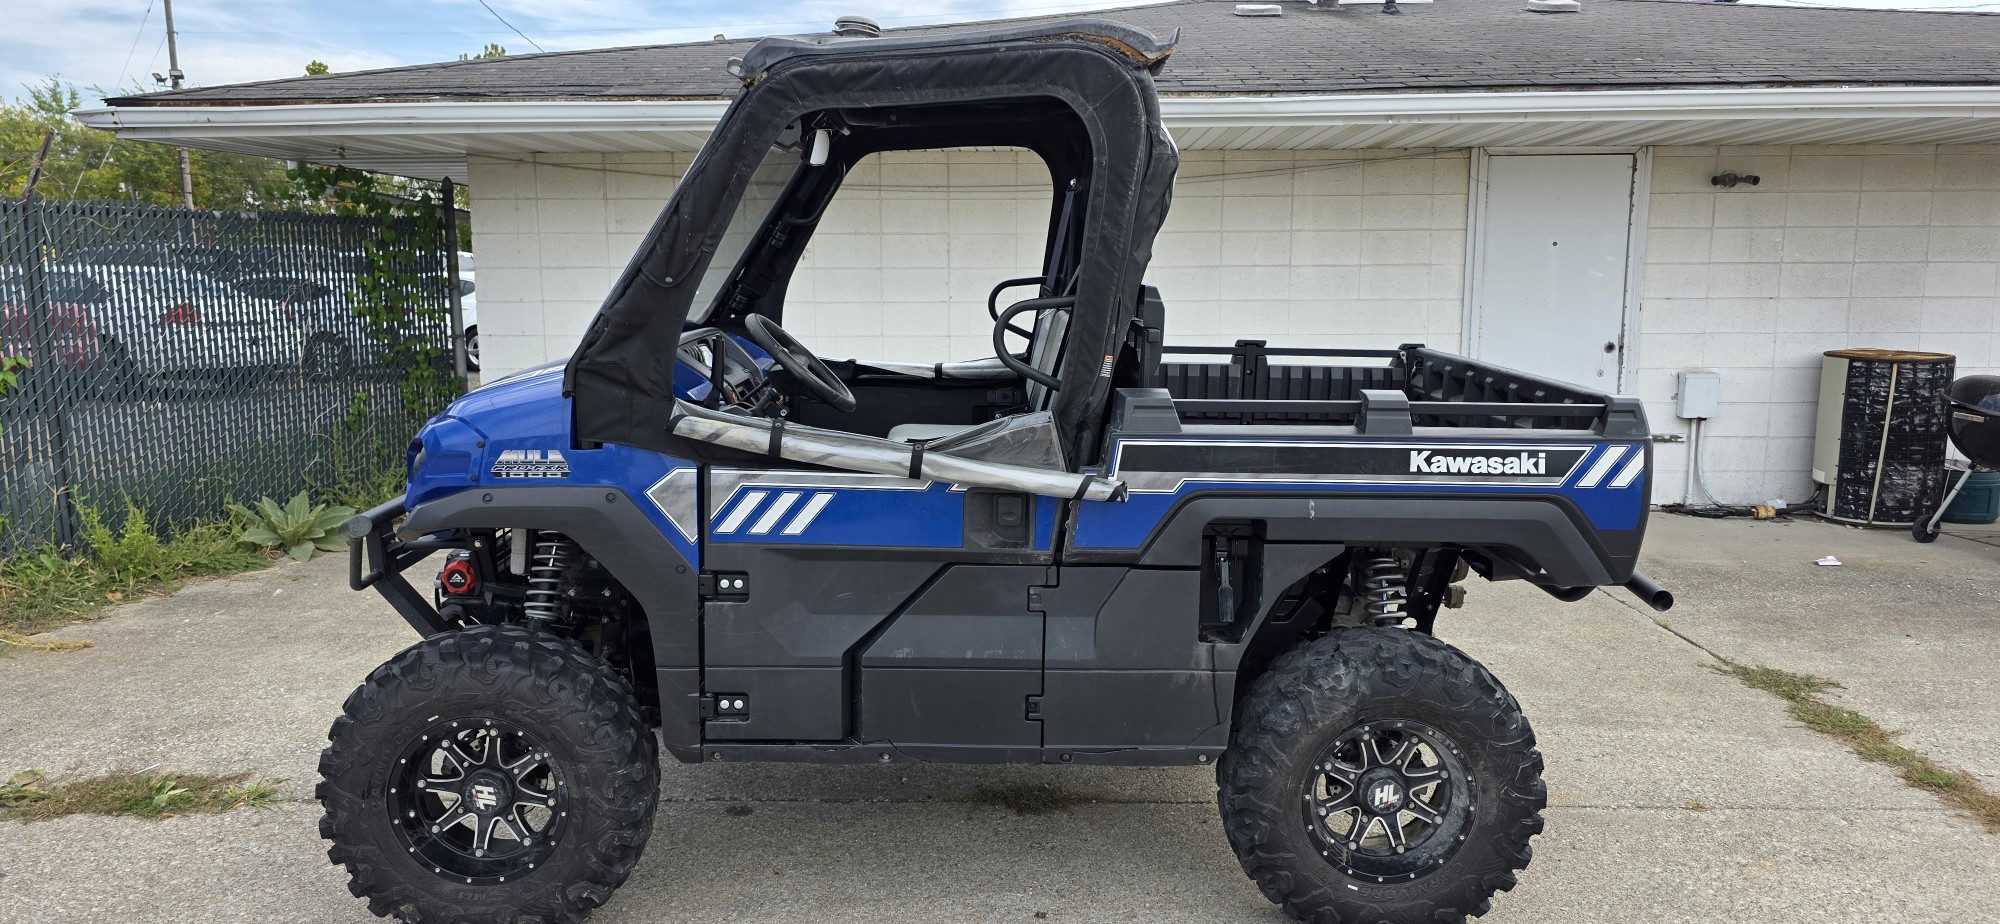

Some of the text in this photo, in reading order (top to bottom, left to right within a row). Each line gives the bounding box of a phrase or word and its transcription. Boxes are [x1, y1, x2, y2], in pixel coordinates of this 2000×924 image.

[494, 449, 568, 464] MULE
[1409, 450, 1546, 475] Kawasaki
[474, 785, 497, 810] HL
[1374, 784, 1400, 806] HL
